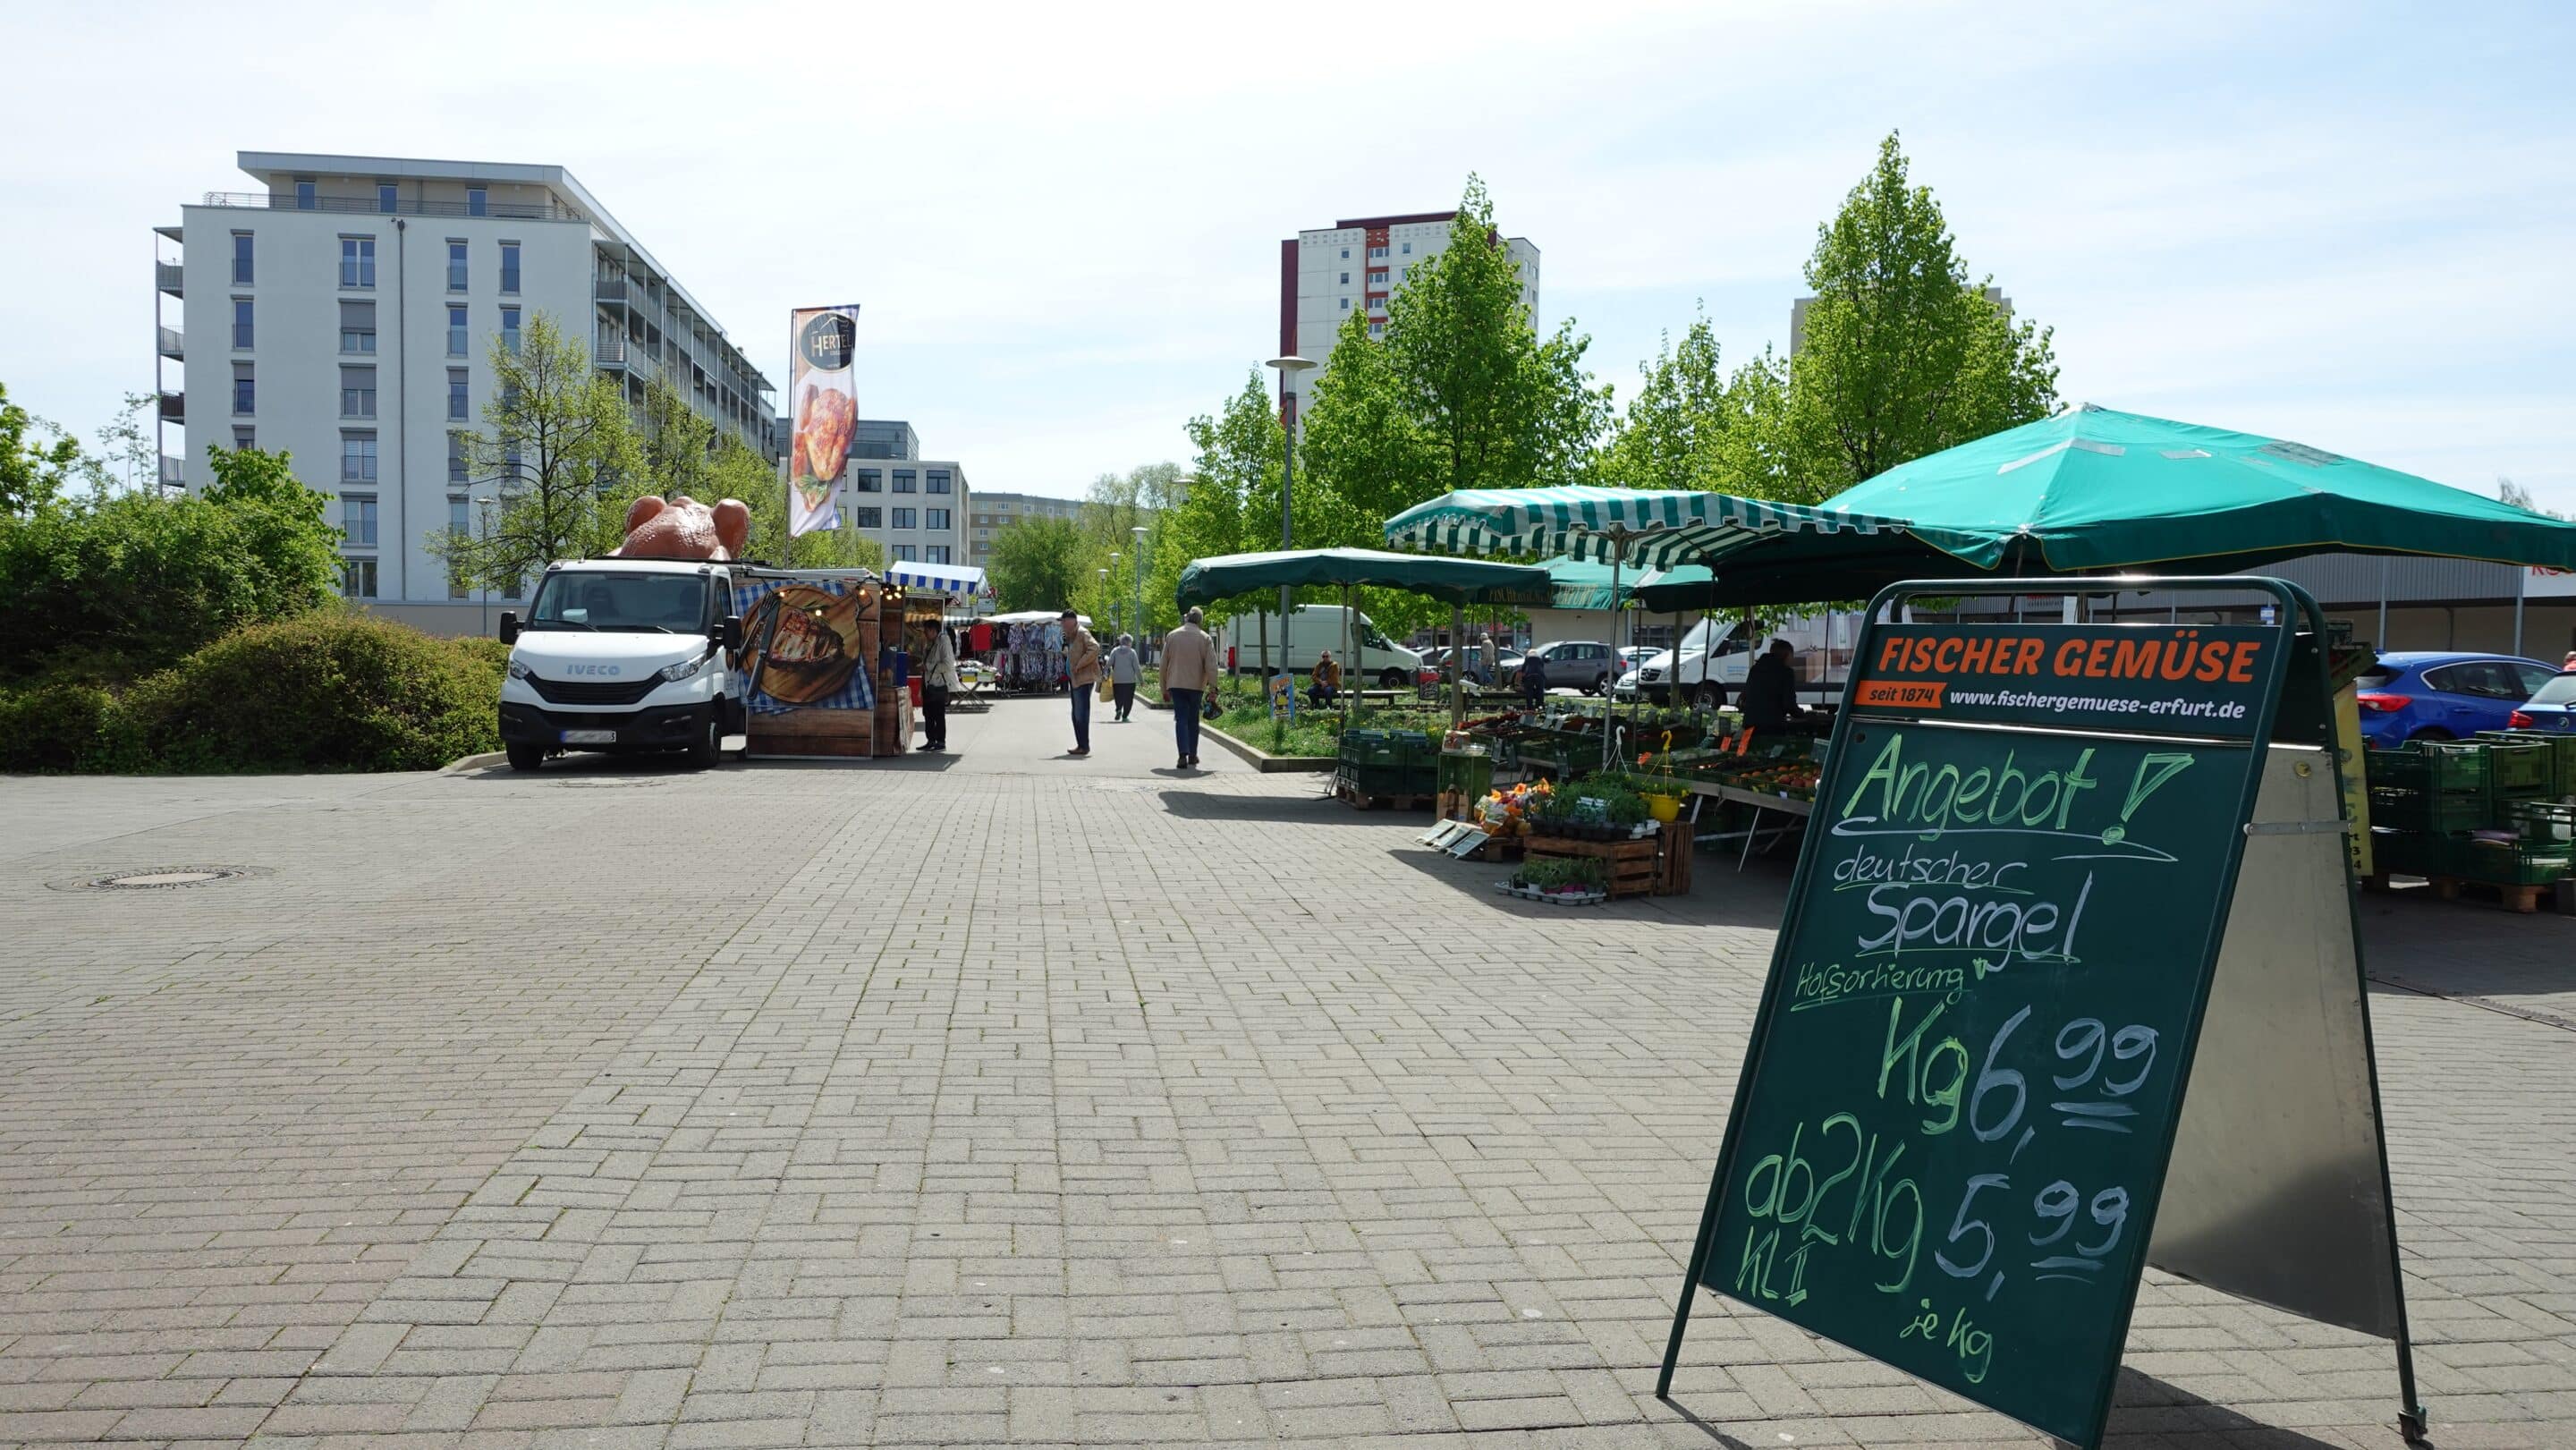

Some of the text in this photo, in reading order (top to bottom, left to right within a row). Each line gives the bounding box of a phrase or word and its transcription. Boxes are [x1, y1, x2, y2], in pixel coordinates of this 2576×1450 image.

[810, 335, 852, 358] HERTEL
[566, 665, 622, 676] IVECO
[1877, 630, 2262, 683] FISCHER GEMÜSE
[1868, 687, 1936, 702] seit 1874
[1949, 690, 2246, 719] www.fischergemuese-erfurt.de
[1834, 844, 2029, 889] deutscher
[1858, 869, 2094, 972] Spargel
[1794, 962, 1964, 1005] Hofsortierung
[1969, 1005, 2160, 1166] 6,99
[1934, 1173, 2130, 1302] 5,99
[1899, 1297, 1939, 1340] je
